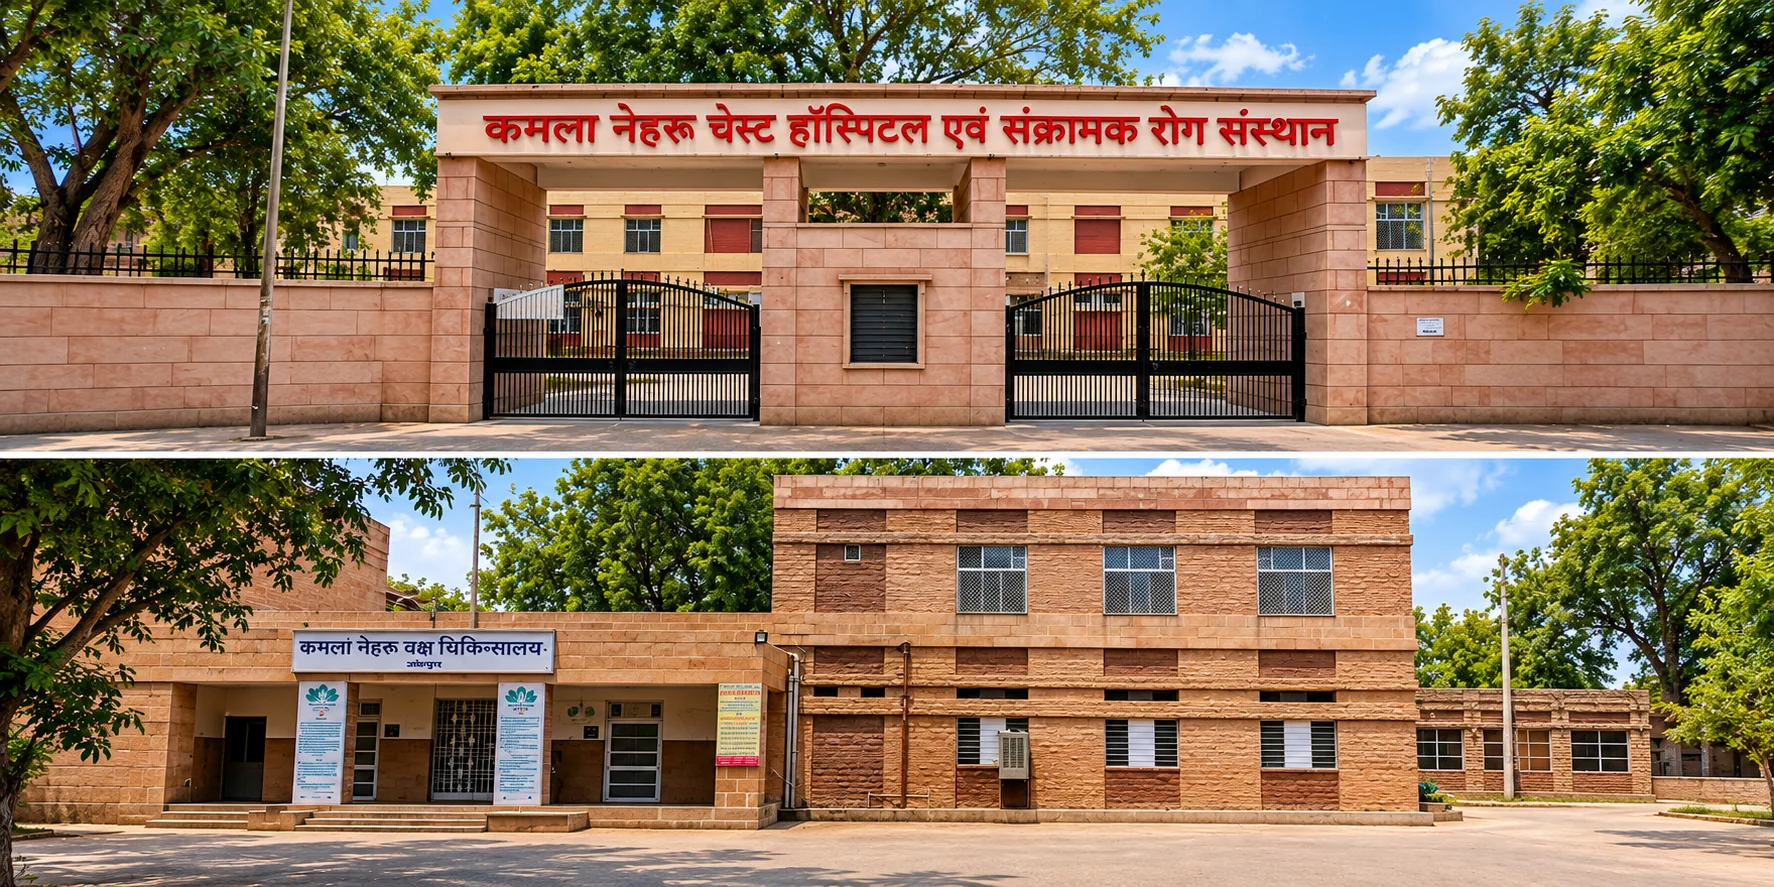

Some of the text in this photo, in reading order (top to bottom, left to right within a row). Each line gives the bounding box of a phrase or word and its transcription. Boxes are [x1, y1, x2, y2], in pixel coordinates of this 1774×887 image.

[483, 103, 1338, 149] कमला नेहरू चेस्ट हॉस्पिटल एवं संक्रामक रोग संस्थान
[403, 640, 434, 657] वक्ष
